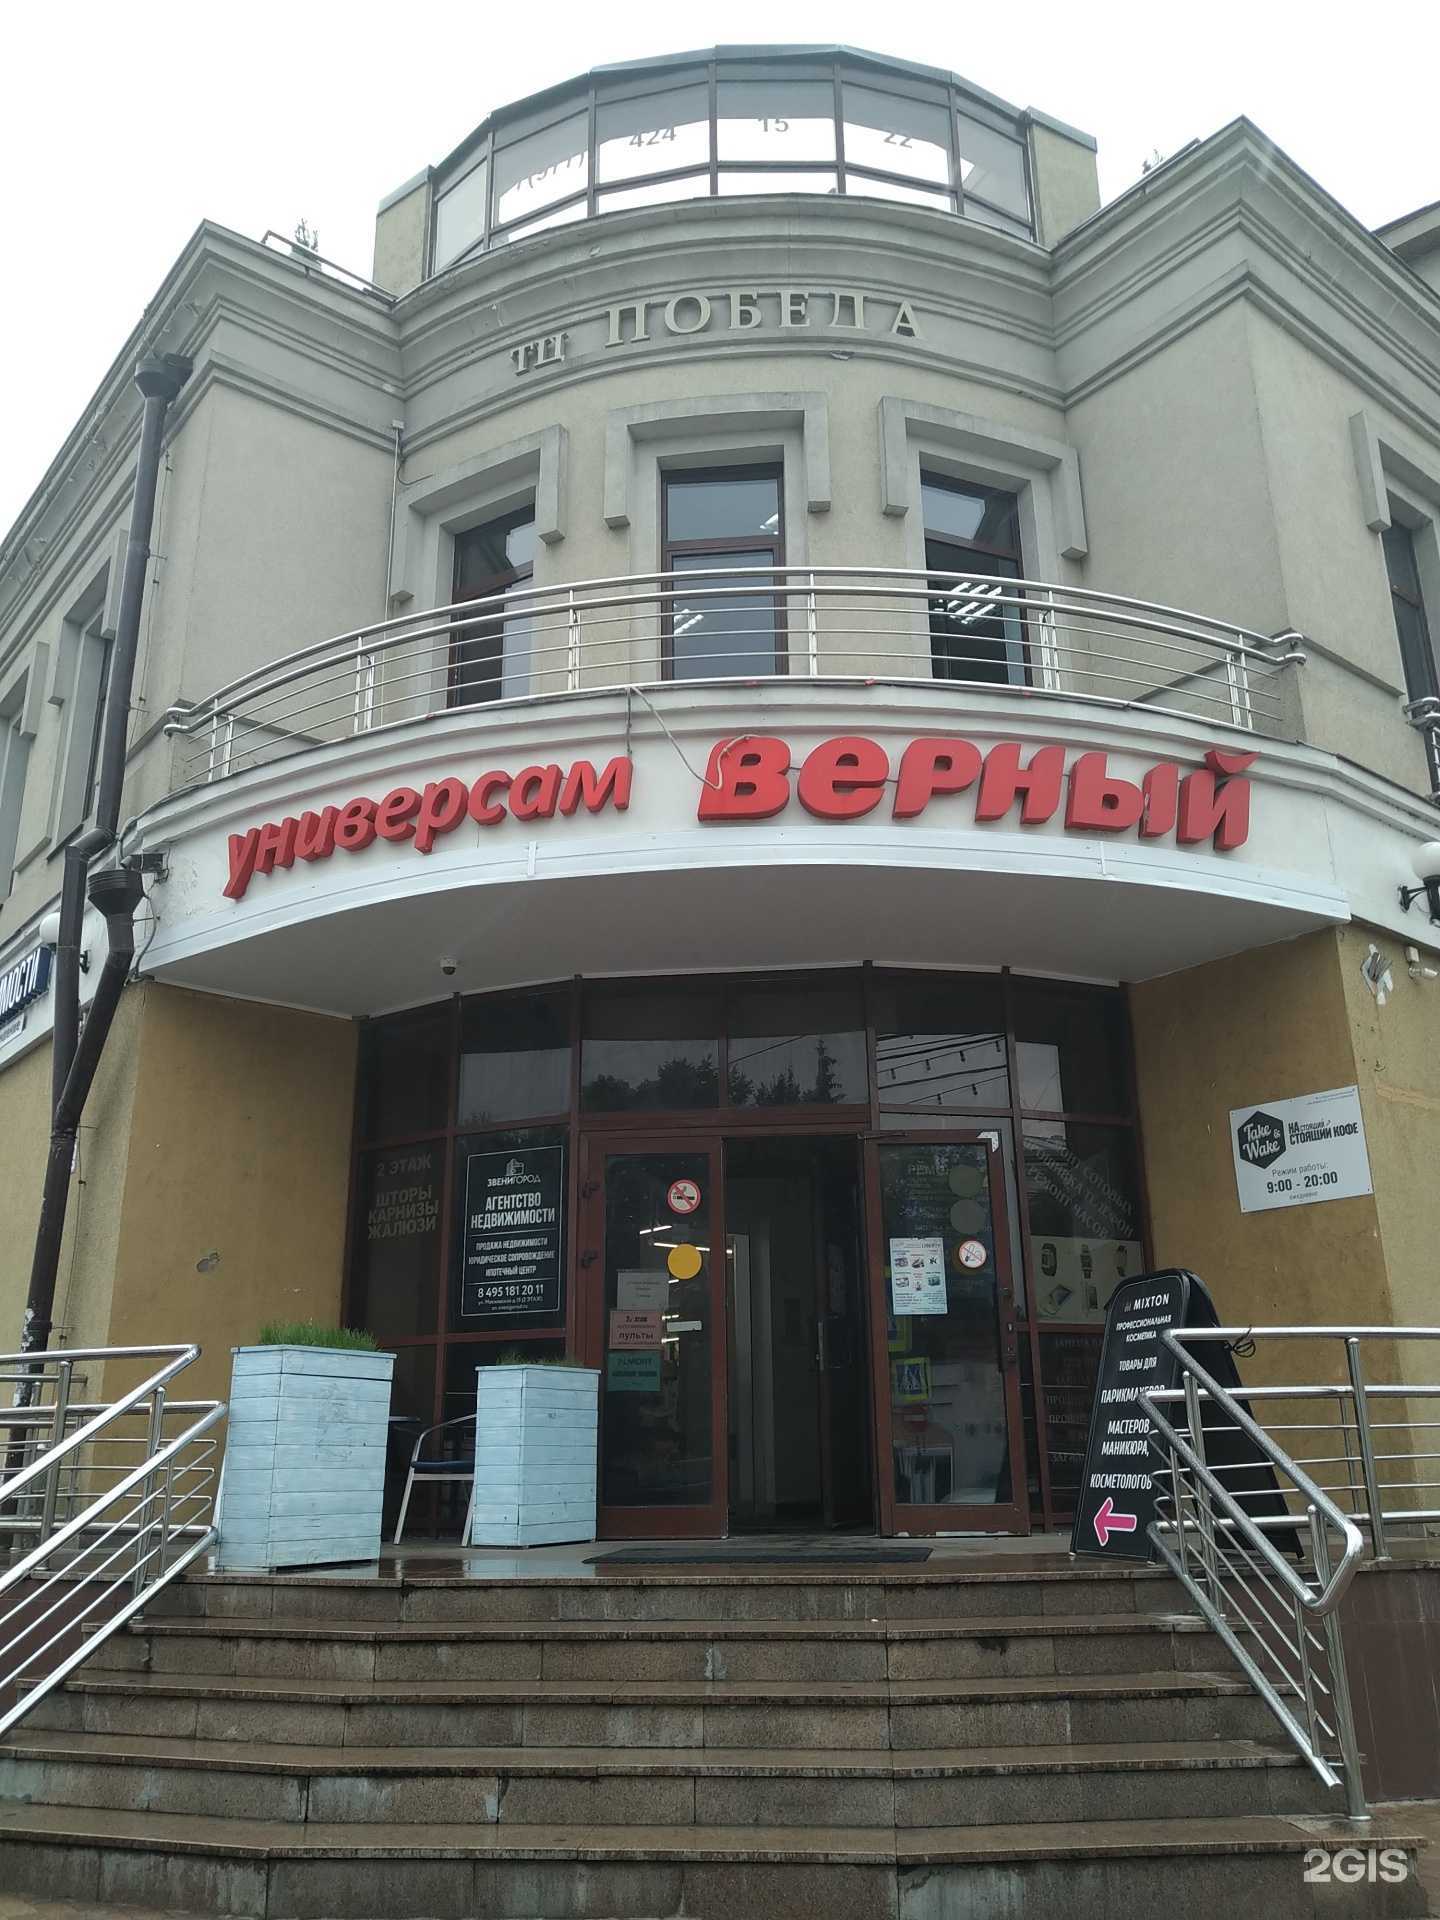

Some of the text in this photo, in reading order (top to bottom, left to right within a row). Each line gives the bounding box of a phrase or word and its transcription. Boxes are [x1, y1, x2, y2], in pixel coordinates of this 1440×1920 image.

[510, 288, 924, 376] ТЦ ПОБЕДА
[1243, 1122, 1272, 1142] Take
[1333, 1122, 1359, 1138] КОФЕ
[1242, 1139, 1281, 1161] Wake
[487, 1174, 541, 1187] ЗВЕНИГОРОД
[1266, 1178, 1293, 1193] 9:00
[1303, 1171, 1338, 1188] 20:00
[375, 1184, 433, 1208] ШТОРЫ
[485, 1191, 542, 1211] АГЕНТСТВО
[367, 1199, 440, 1224] КАРНИЗЫ
[471, 1207, 556, 1230] НЕДВИЖИМОСТИ
[367, 1215, 437, 1240] ЖАЛЮЗИ
[477, 1283, 544, 1298] 8 495 181 20 11
[1133, 1293, 1170, 1310] MIXTON
[1116, 1314, 1172, 1331] ПРОФЕССИОНАЛЬНАЯ
[1125, 1330, 1157, 1342] КОСМЕТИКА
[1119, 1356, 1158, 1371] ТОВАРЫ ДЛЯ
[1107, 1418, 1150, 1435] МАСТЕРОВ
[1101, 1440, 1150, 1457] МАНИКЮРА,
